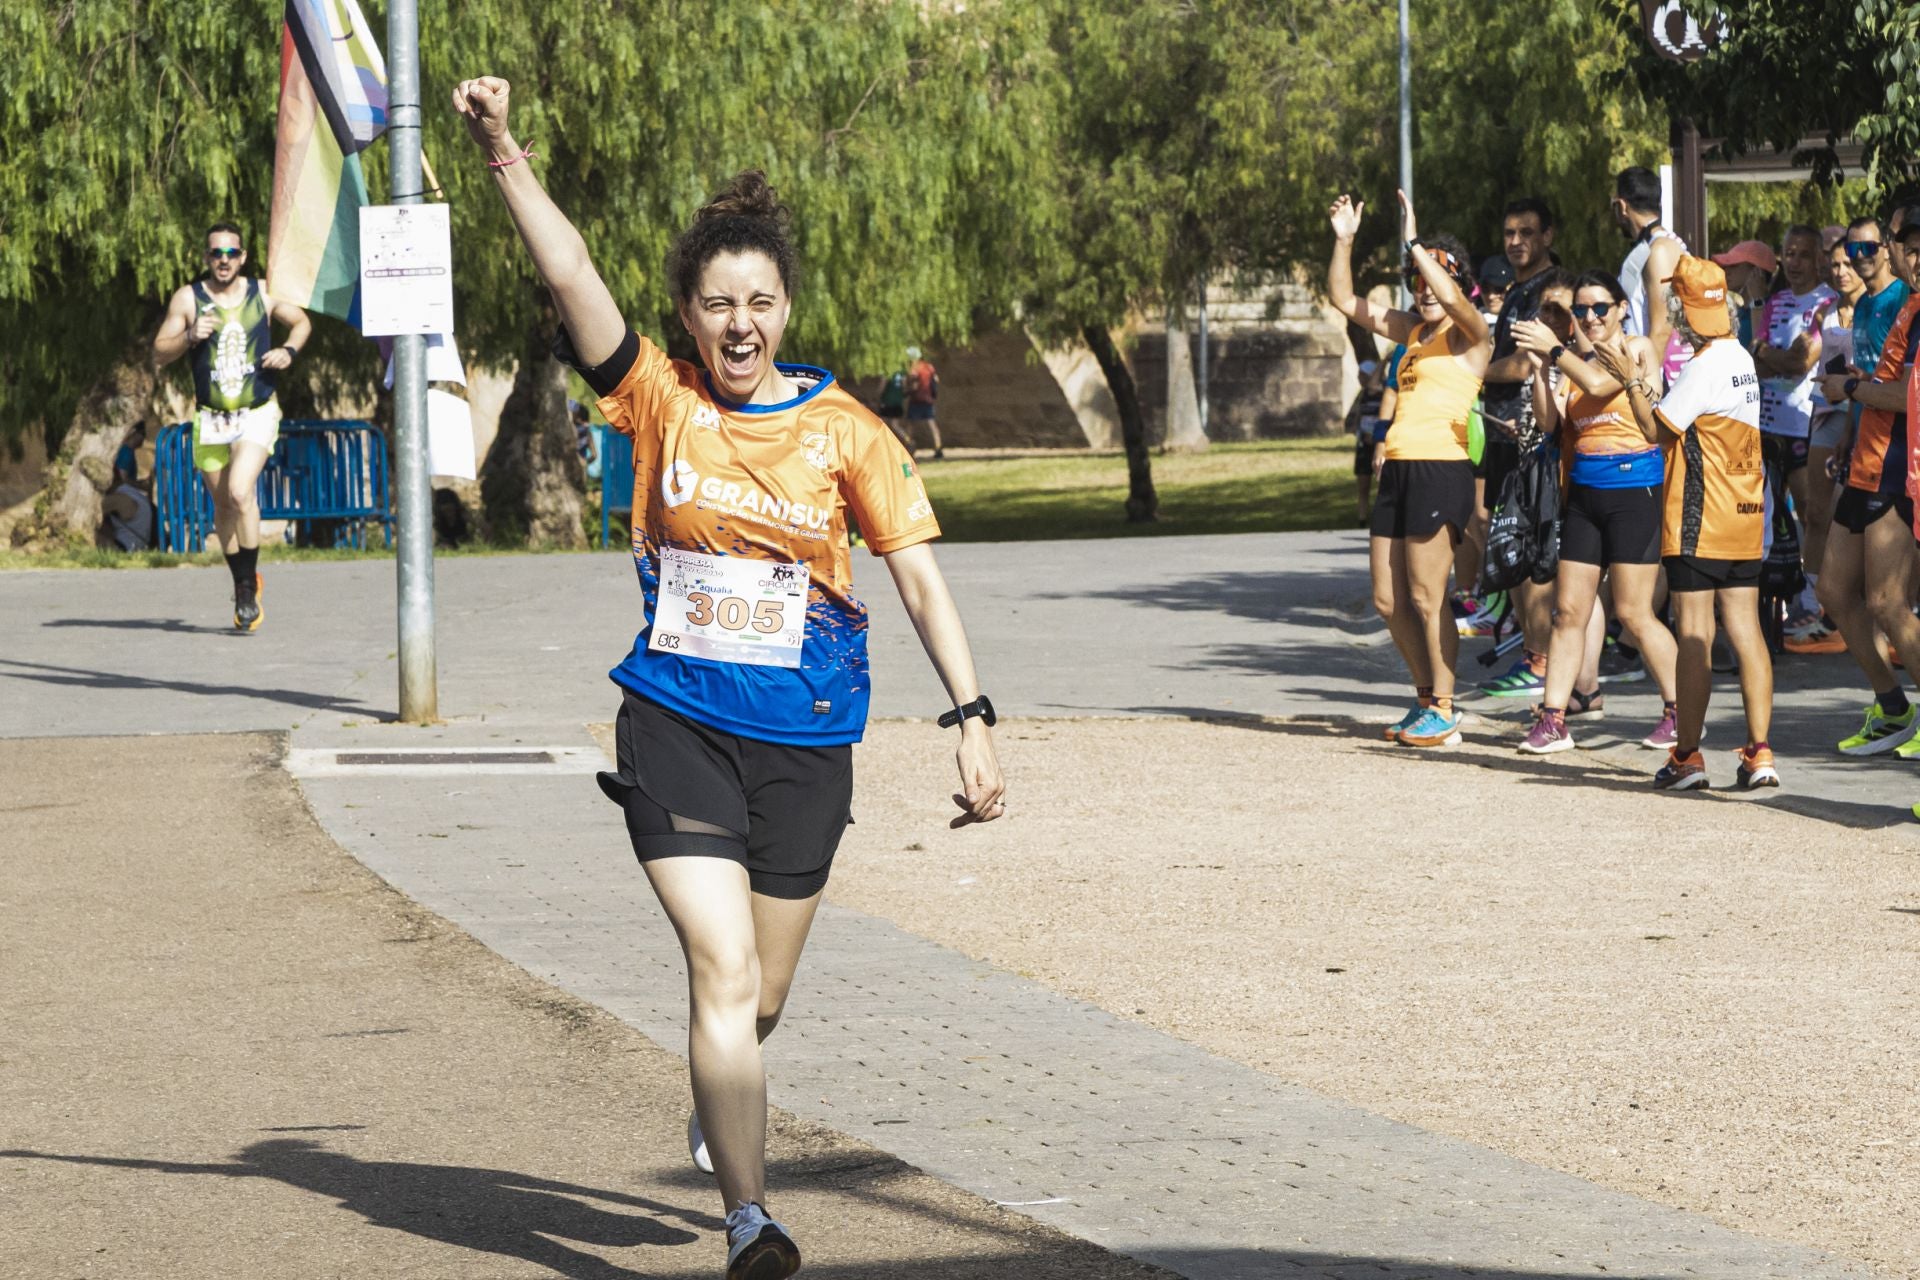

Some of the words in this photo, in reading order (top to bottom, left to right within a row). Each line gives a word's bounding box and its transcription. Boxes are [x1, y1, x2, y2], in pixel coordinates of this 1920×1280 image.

[701, 476, 829, 531] GRANISUL
[675, 554, 714, 569] CARRERA
[699, 584, 733, 595] aqualia
[758, 579, 798, 589] CIRCUIT
[686, 592, 784, 634] 305
[658, 633, 680, 650] 5K
